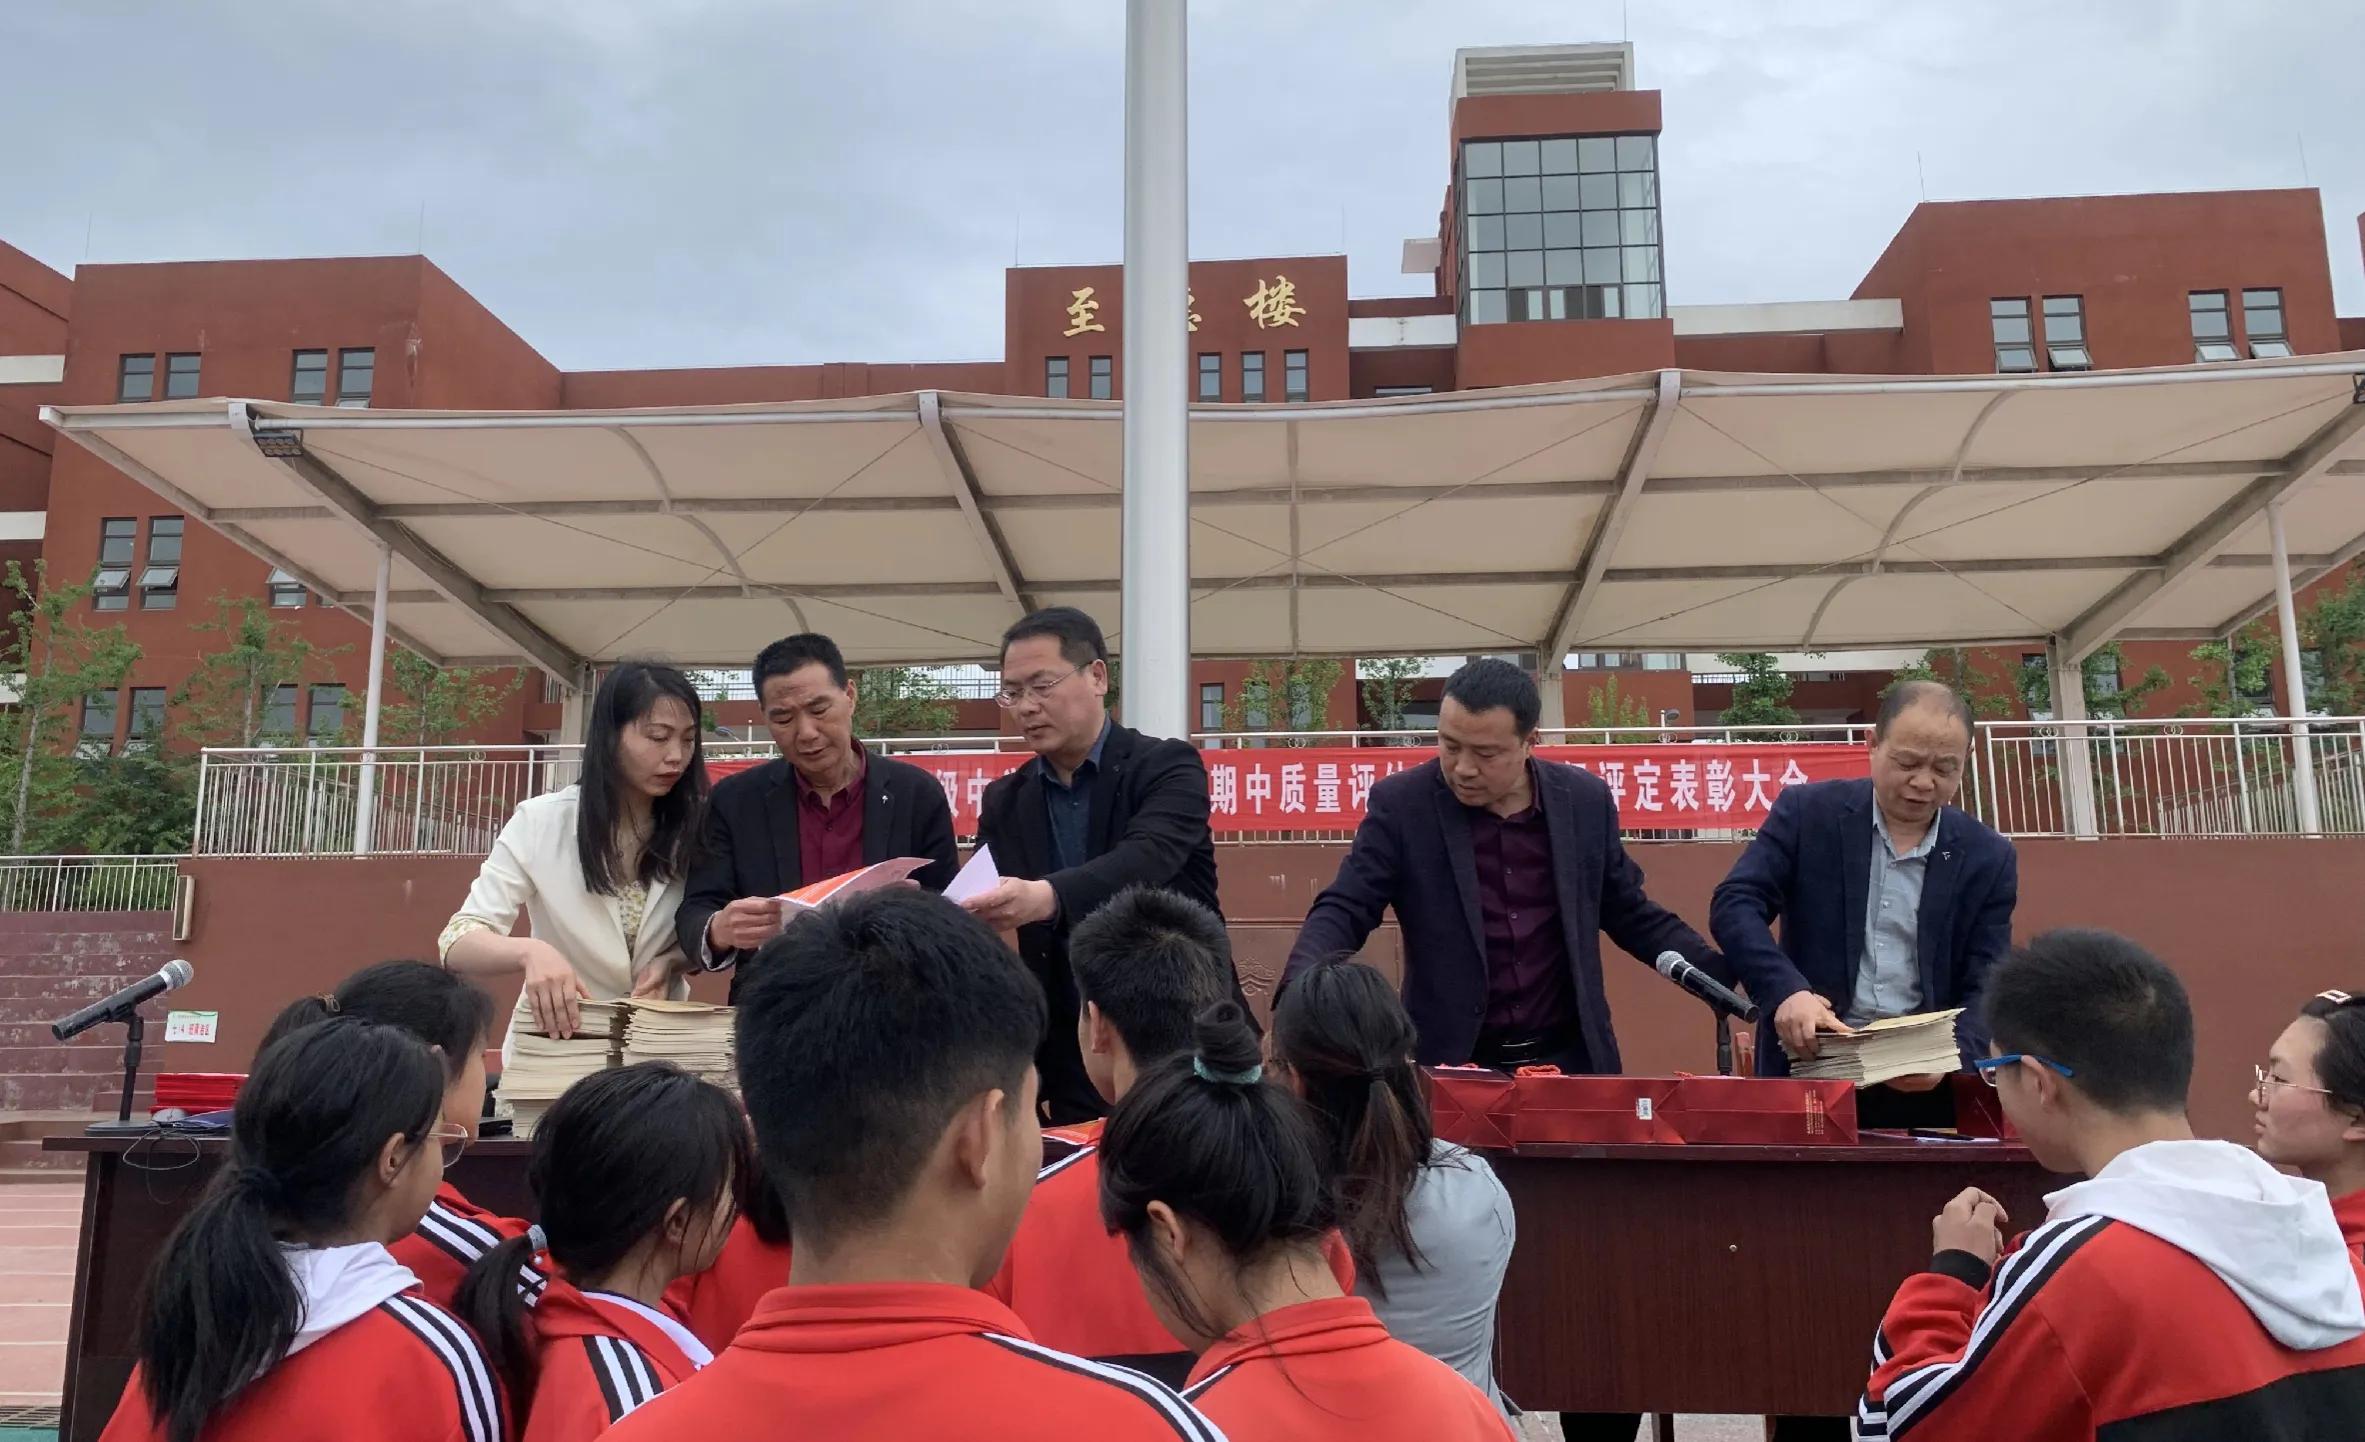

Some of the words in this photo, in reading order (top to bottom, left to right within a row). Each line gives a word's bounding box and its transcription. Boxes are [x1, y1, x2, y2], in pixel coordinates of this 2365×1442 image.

[1063, 275, 1306, 338] 至楼
[1210, 761, 1403, 815] 期中质量评
[1565, 758, 1808, 812] 评定表彰大
